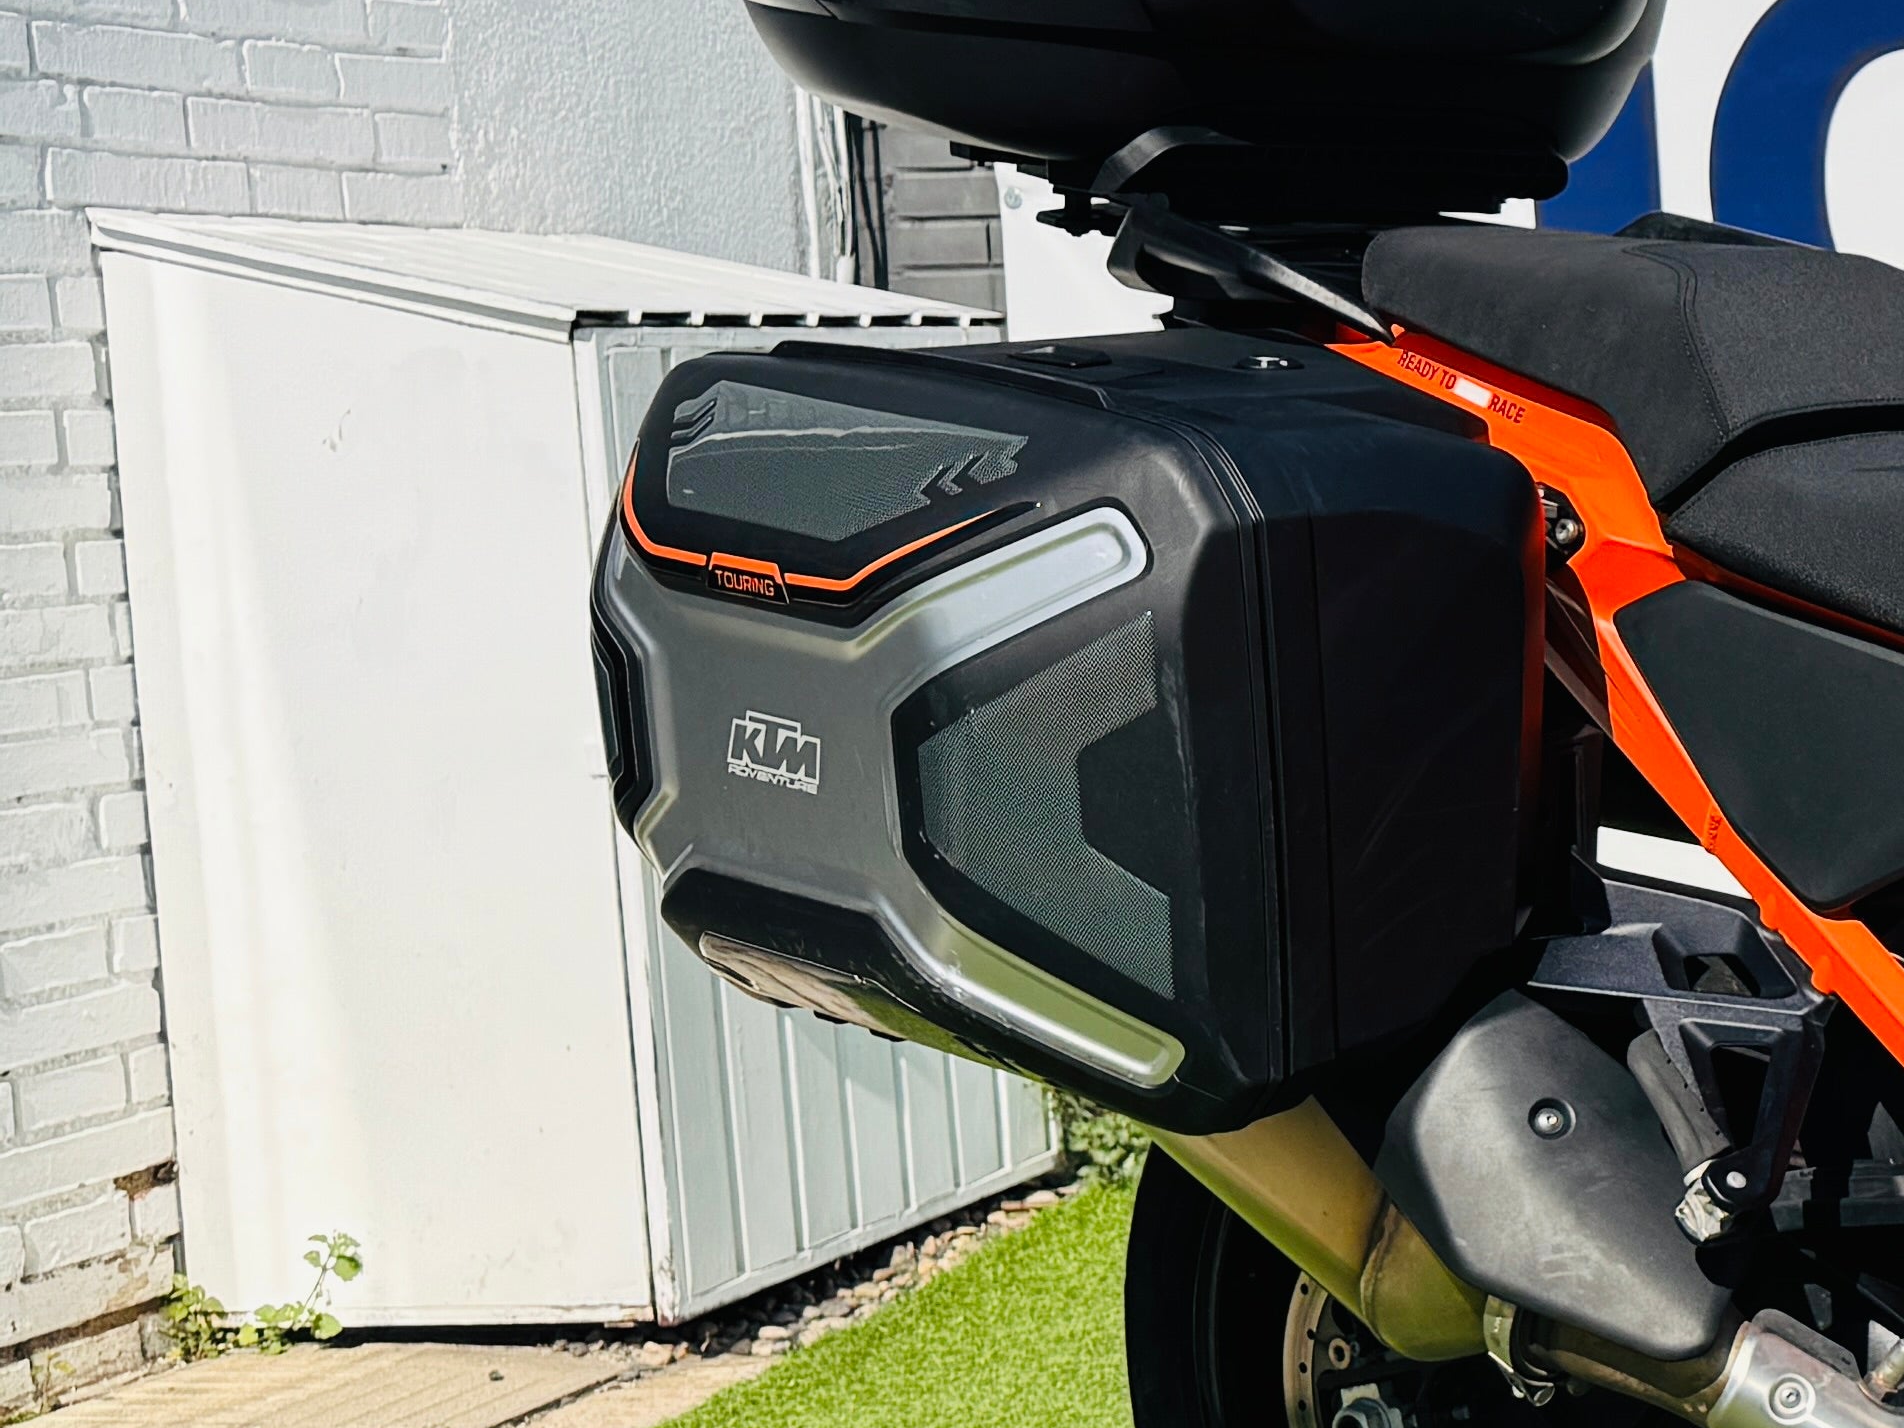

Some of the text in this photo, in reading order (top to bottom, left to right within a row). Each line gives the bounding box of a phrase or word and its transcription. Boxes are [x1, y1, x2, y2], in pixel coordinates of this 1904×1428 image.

[1397, 350, 1526, 424] READY TO RACE
[714, 569, 776, 597] TOURING
[727, 710, 821, 786] KTM
[728, 764, 818, 795] ADVENTURE
